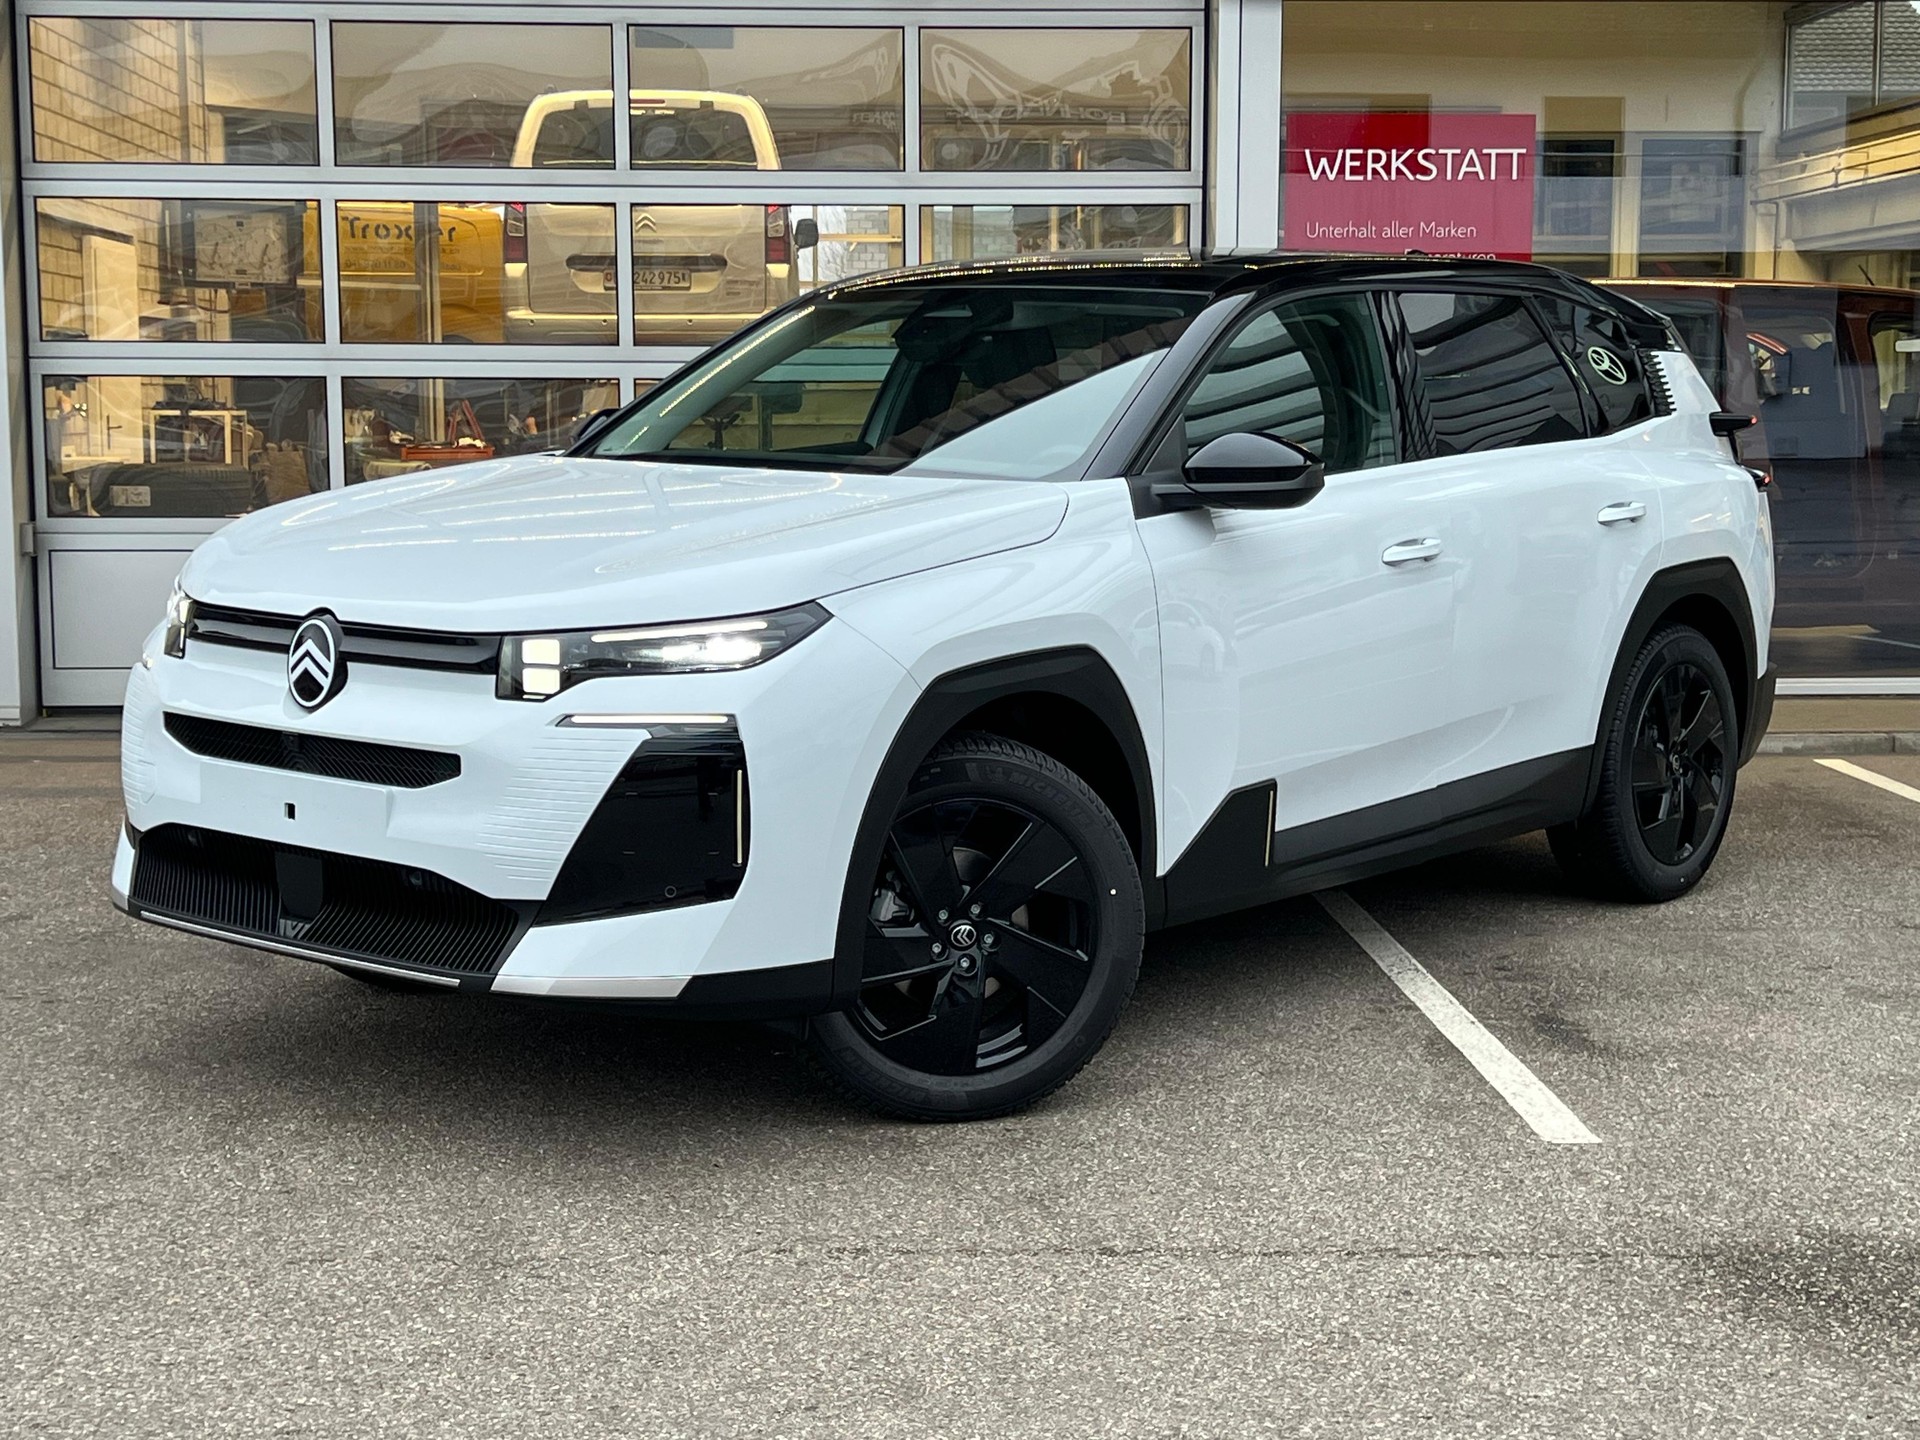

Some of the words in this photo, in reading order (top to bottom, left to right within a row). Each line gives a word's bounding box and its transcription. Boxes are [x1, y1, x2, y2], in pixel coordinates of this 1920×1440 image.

[1304, 148, 1527, 181] WERKSTATT
[340, 215, 457, 242] Troxr
[1306, 220, 1377, 239] Unterhalt
[1381, 220, 1414, 239] aller
[1419, 220, 1477, 239] Marken
